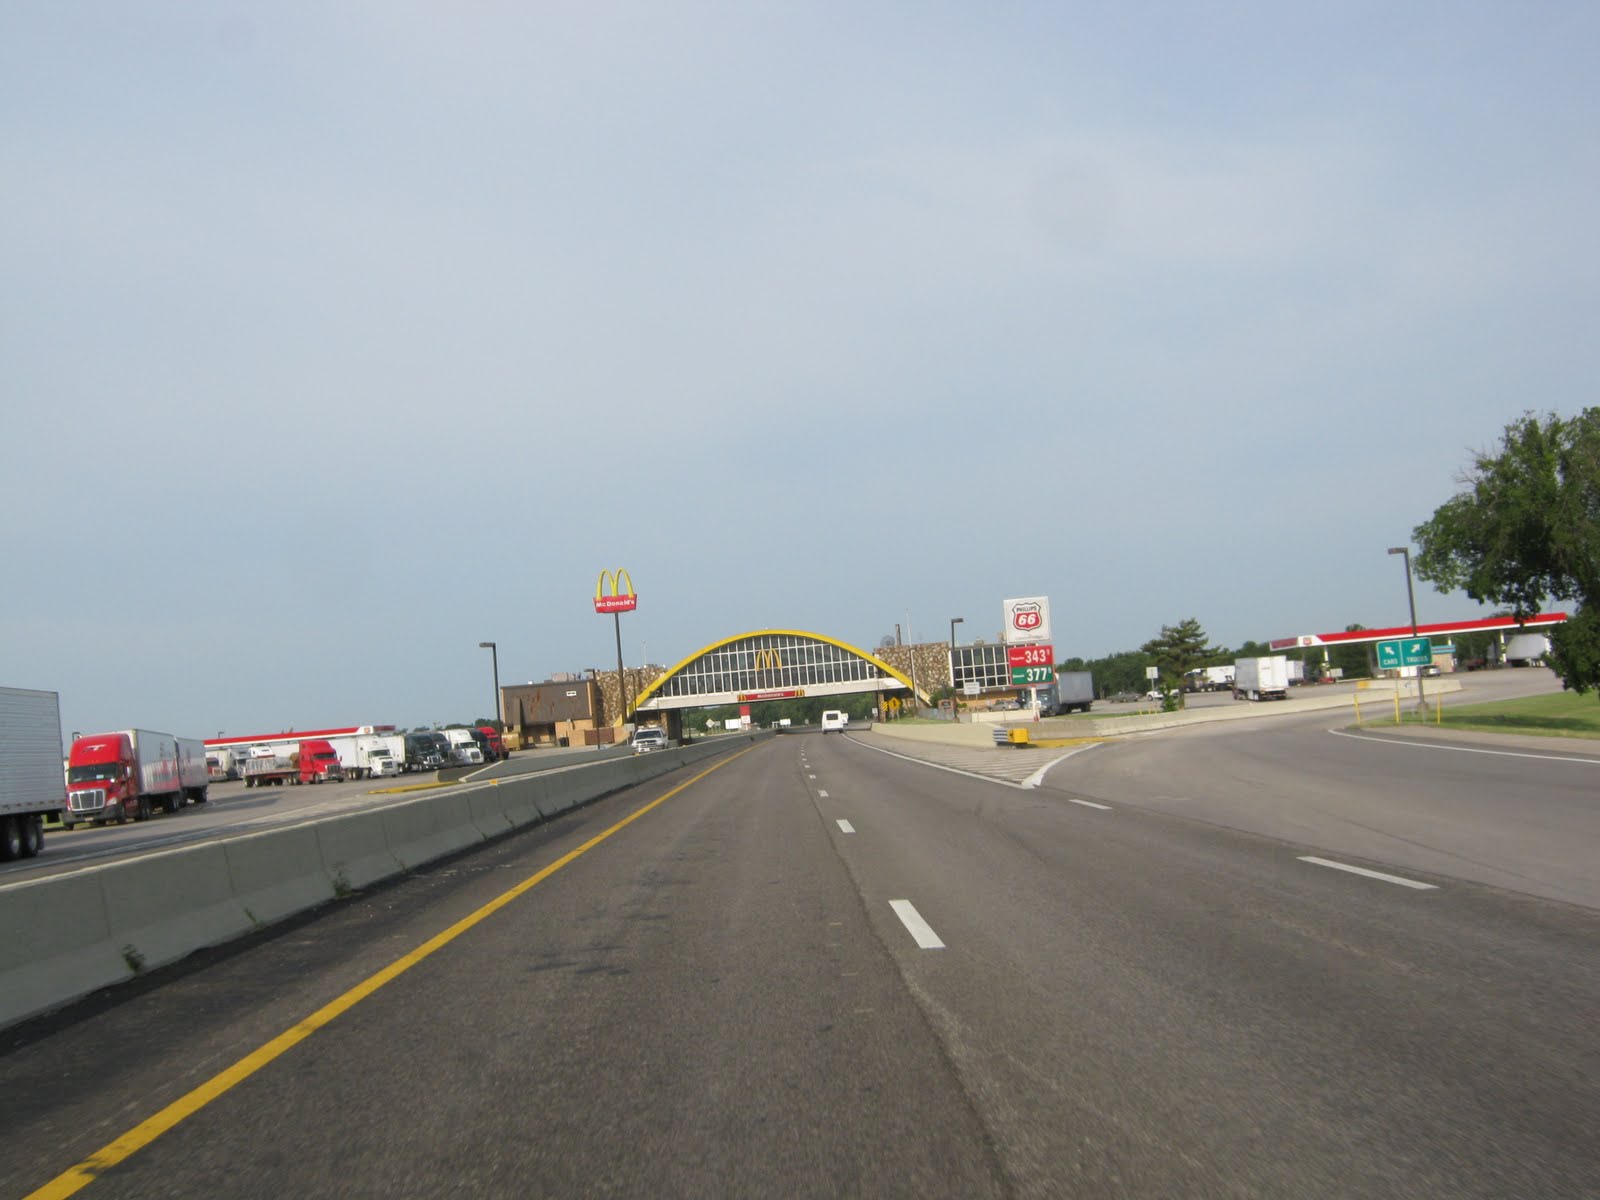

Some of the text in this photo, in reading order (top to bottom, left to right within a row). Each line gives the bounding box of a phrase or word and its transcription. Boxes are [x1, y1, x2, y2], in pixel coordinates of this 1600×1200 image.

[595, 600, 635, 608] McDonald's
[1016, 605, 1037, 613] PHILLIPS
[1018, 613, 1037, 626] 66
[1383, 658, 1398, 666] CARS
